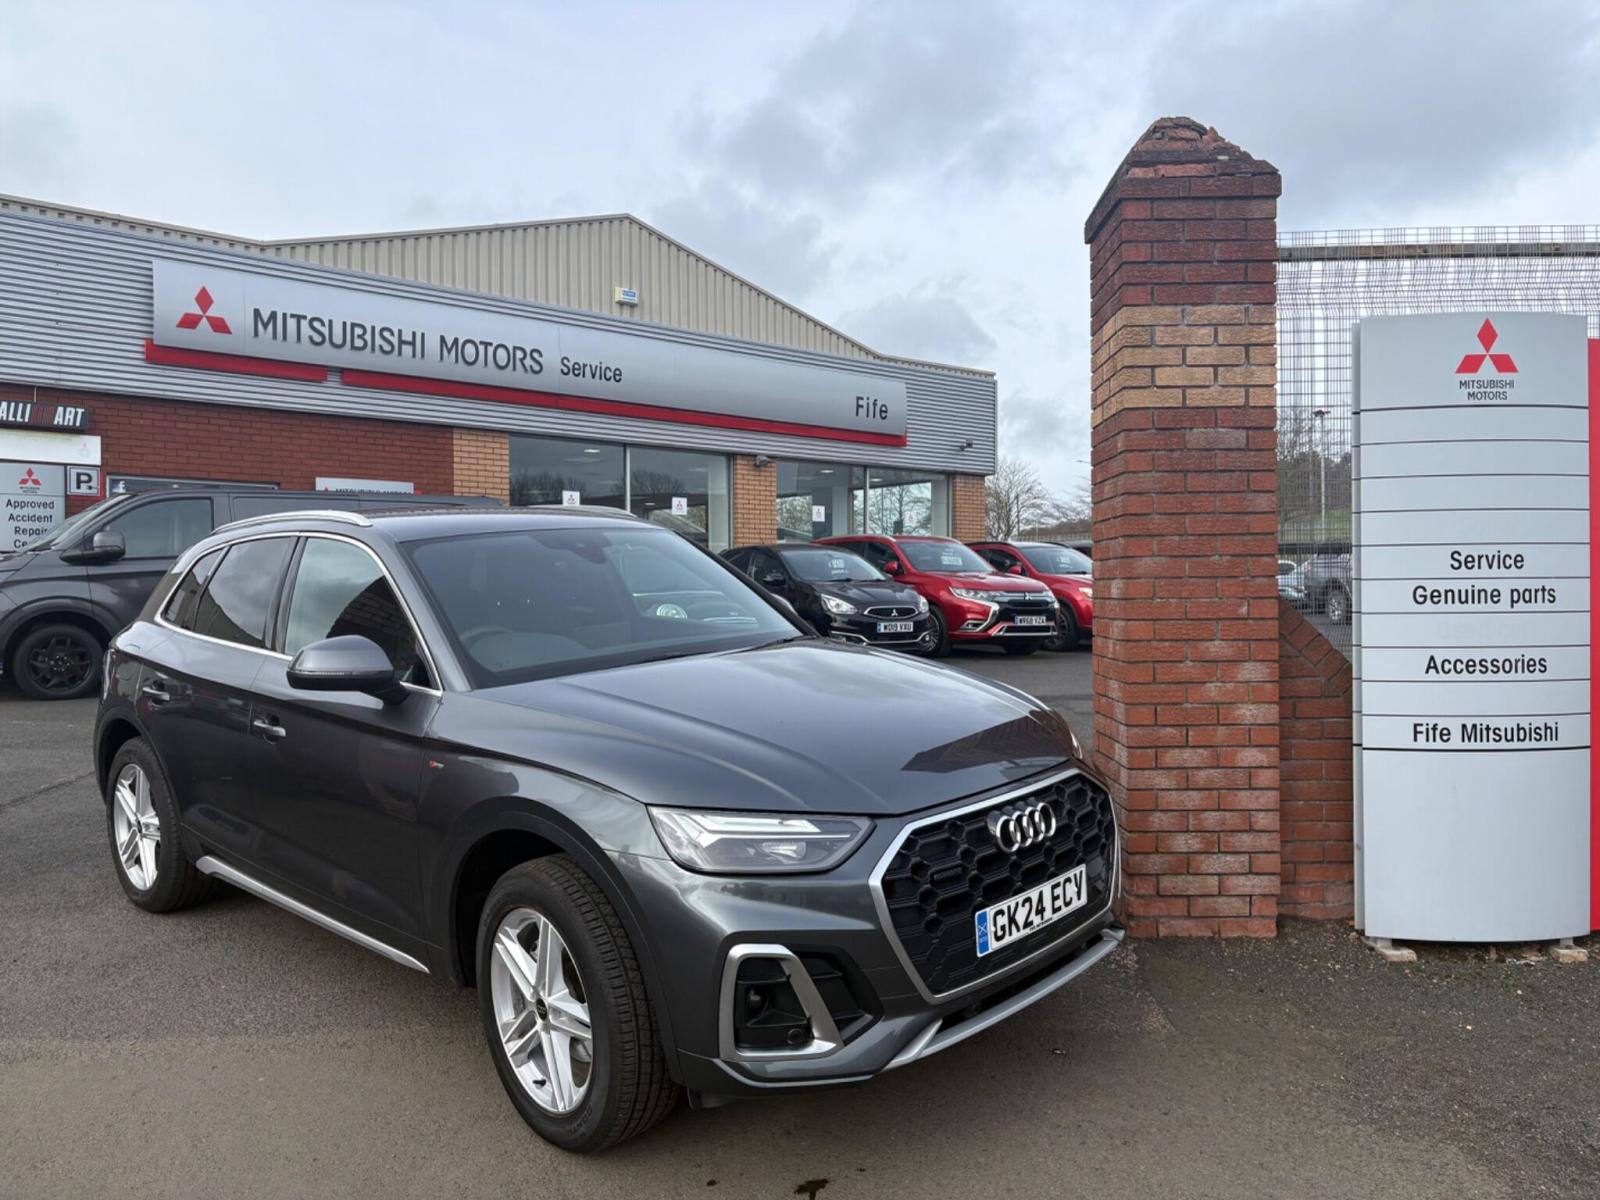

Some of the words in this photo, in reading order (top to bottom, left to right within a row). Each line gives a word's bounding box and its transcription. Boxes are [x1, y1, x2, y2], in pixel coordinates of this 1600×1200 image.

[252, 308, 426, 361] MITSUBISHI
[439, 333, 544, 375] MOTORS
[560, 356, 622, 383] Service
[855, 395, 888, 420] Fife
[1459, 380, 1515, 390] MITSUBISHI
[1467, 391, 1508, 401] MOTORS
[6, 499, 55, 511] Approved
[8, 513, 53, 523] Accident
[14, 527, 48, 539] Repair
[1450, 550, 1525, 570] Service
[1412, 585, 1502, 605] Genuine
[1509, 585, 1557, 608] parts
[1425, 654, 1548, 675] Accessories
[1412, 723, 1451, 743] Fife
[1461, 721, 1559, 743] Mitsubishi
[992, 889, 1046, 942] GK24
[1050, 869, 1084, 915] ECV
